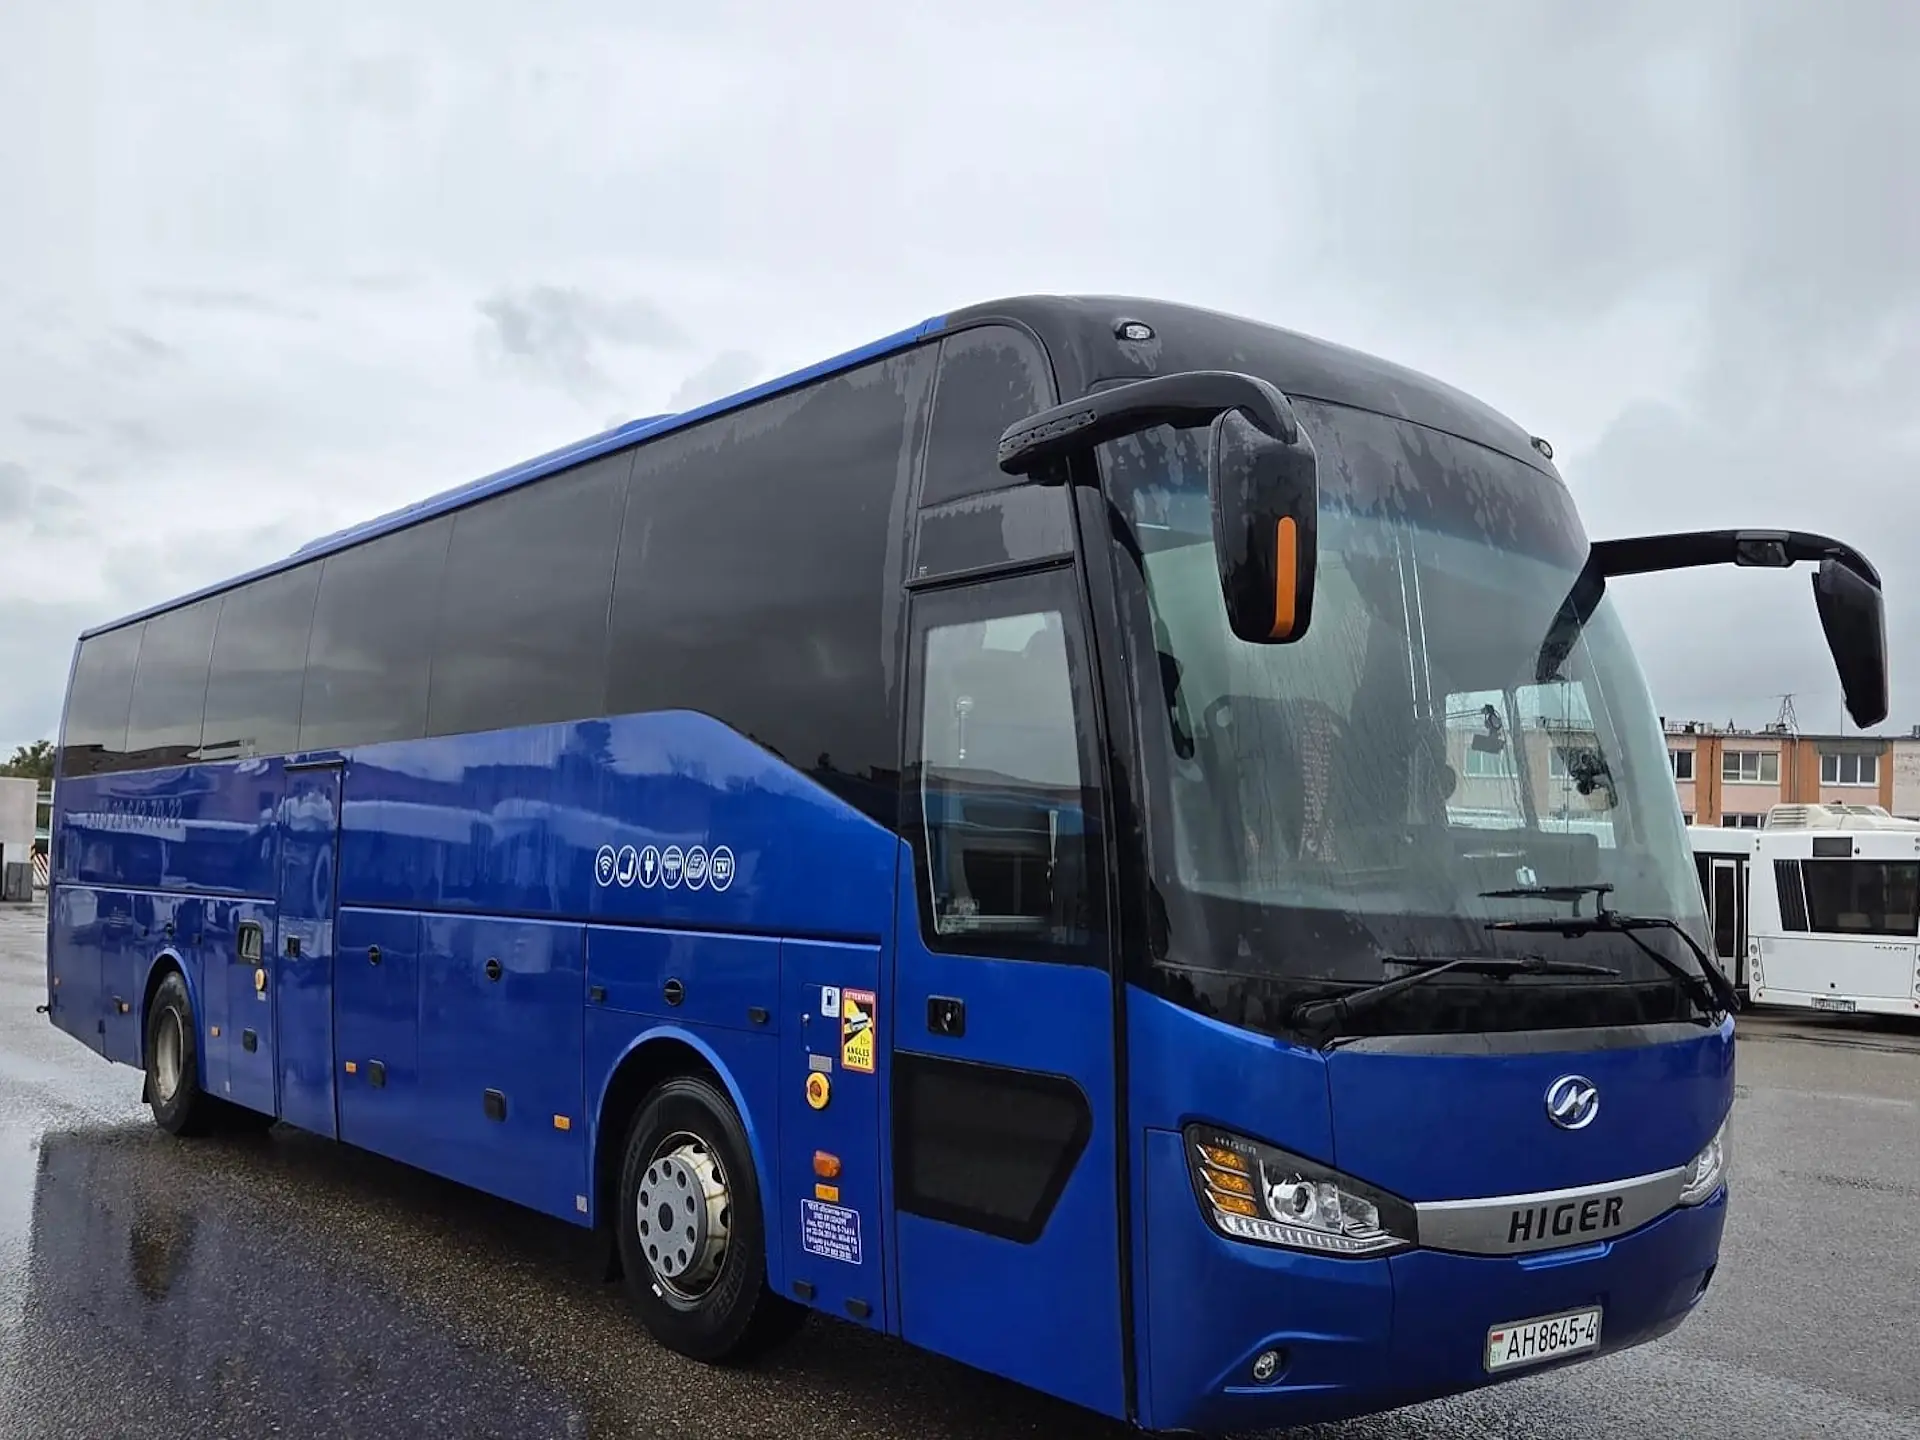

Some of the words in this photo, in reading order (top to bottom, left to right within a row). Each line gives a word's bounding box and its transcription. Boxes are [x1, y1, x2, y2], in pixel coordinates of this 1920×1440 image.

[716, 861, 728, 873] TV
[847, 1045, 870, 1057] ANGLES
[848, 1055, 869, 1066] MORTS
[1507, 1196, 1623, 1243] HIGER
